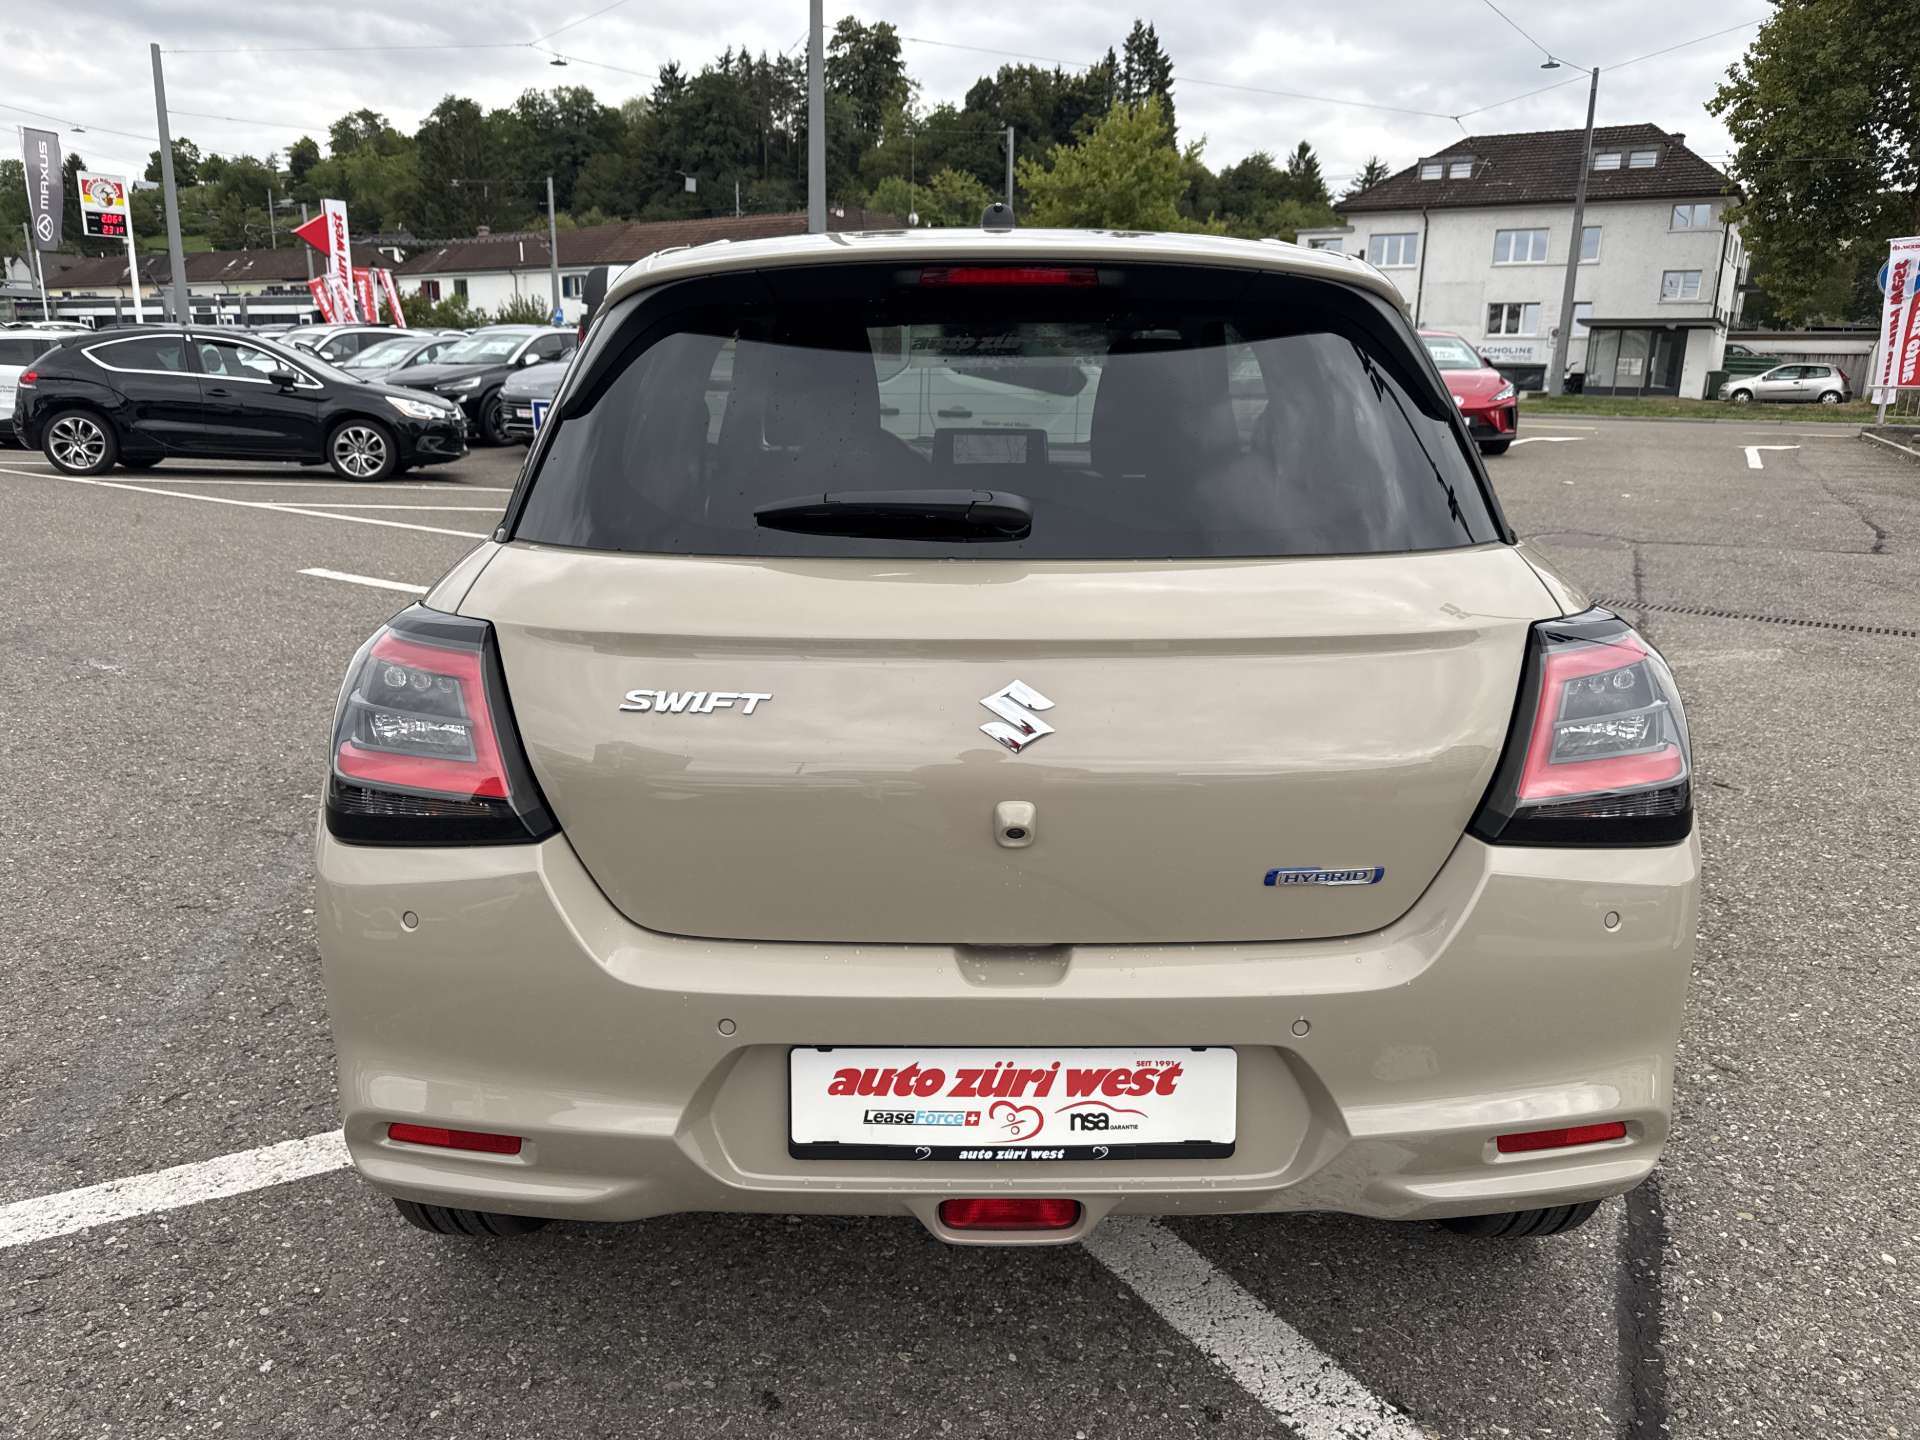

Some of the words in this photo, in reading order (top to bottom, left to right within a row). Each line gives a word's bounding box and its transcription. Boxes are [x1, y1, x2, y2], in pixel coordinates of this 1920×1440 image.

[39, 140, 49, 210] MAXUS
[332, 211, 345, 252] west
[1475, 345, 1533, 354] TACHOLINE
[619, 689, 773, 715] SWIFT
[1284, 871, 1368, 883] HYBRID
[828, 1061, 946, 1098] auto
[946, 1061, 1061, 1098] züri
[1066, 1061, 1185, 1098] west
[863, 1109, 964, 1126] LeaseForce
[1070, 1112, 1109, 1131] nsa
[959, 1149, 992, 1160] auto
[996, 1148, 1028, 1160] züri
[1031, 1149, 1065, 1160] west
